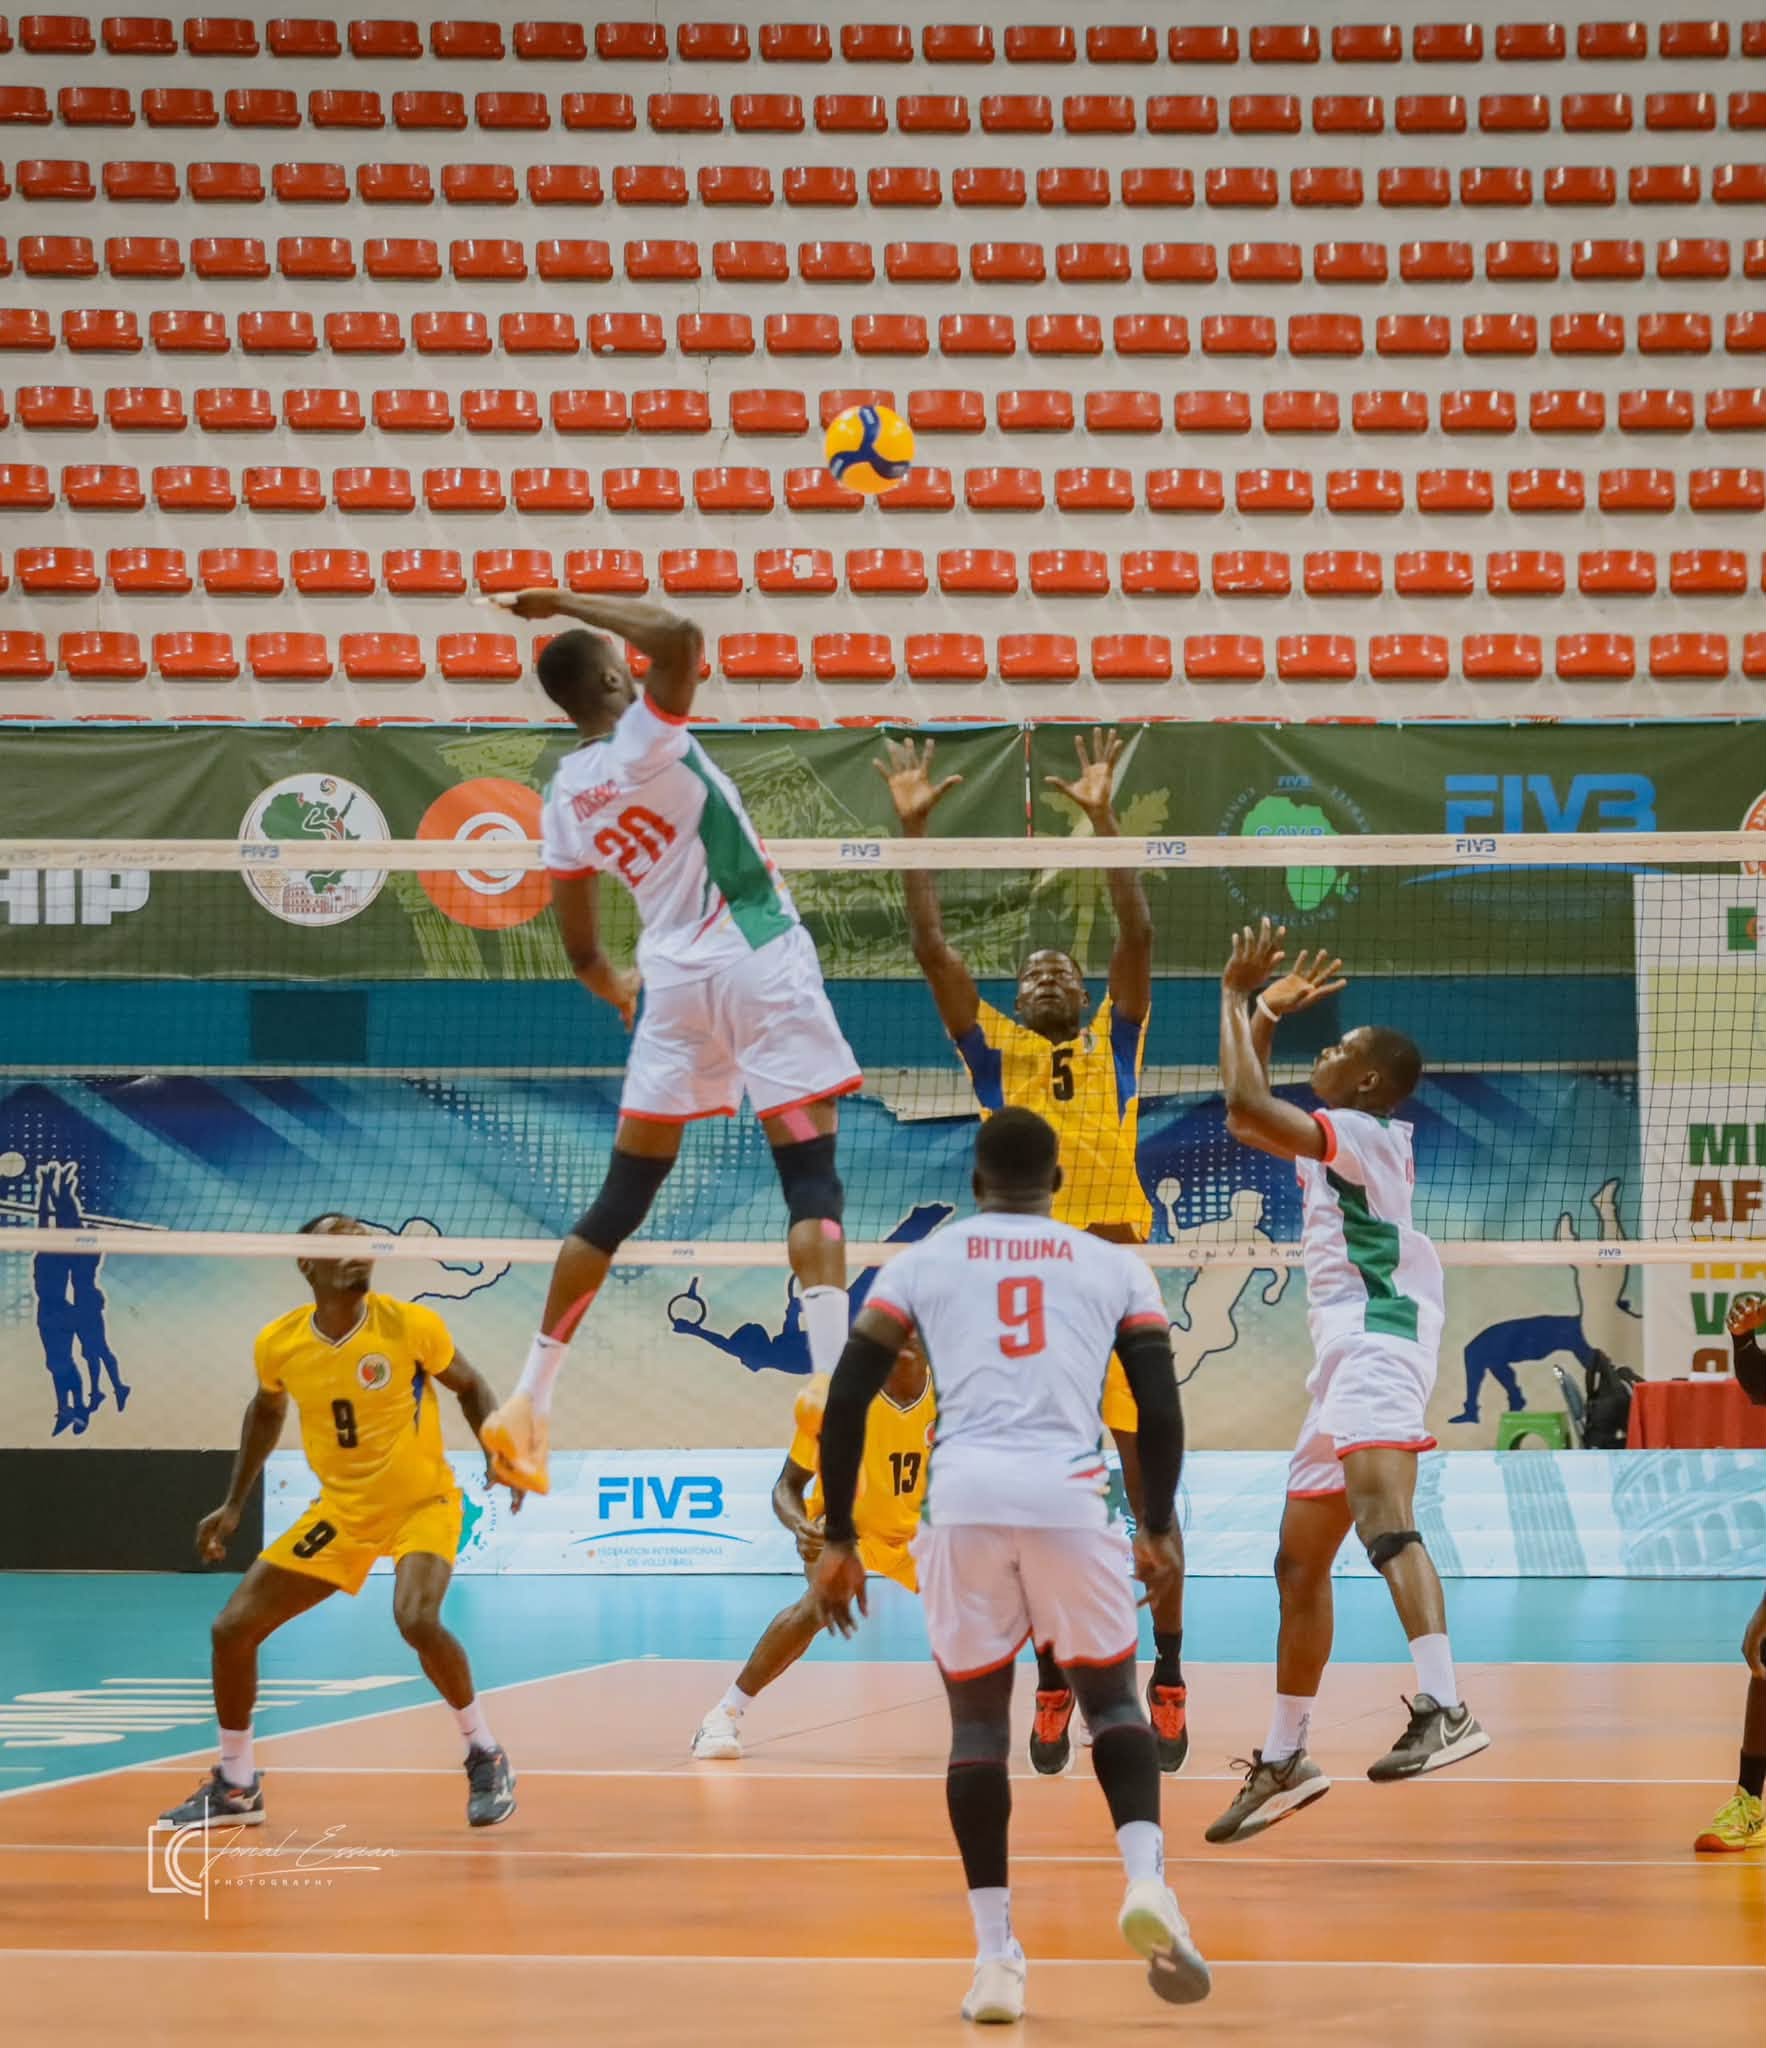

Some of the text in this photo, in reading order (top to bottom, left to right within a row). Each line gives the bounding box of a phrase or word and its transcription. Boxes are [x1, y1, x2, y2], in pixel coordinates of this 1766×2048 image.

[1445, 774, 1657, 833] FIVB
[594, 806, 677, 888] 20
[841, 843, 881, 857] FIVB
[1146, 841, 1187, 855] FIVB
[1456, 838, 1496, 852] FIVB
[1052, 1048, 1074, 1101] 5
[967, 1236, 1073, 1262] BITOUNA
[997, 1276, 1046, 1359] 9
[332, 1398, 358, 1448] 9
[888, 1451, 922, 1496] 13
[598, 1476, 723, 1519] FIVB
[292, 1520, 337, 1558] 9
